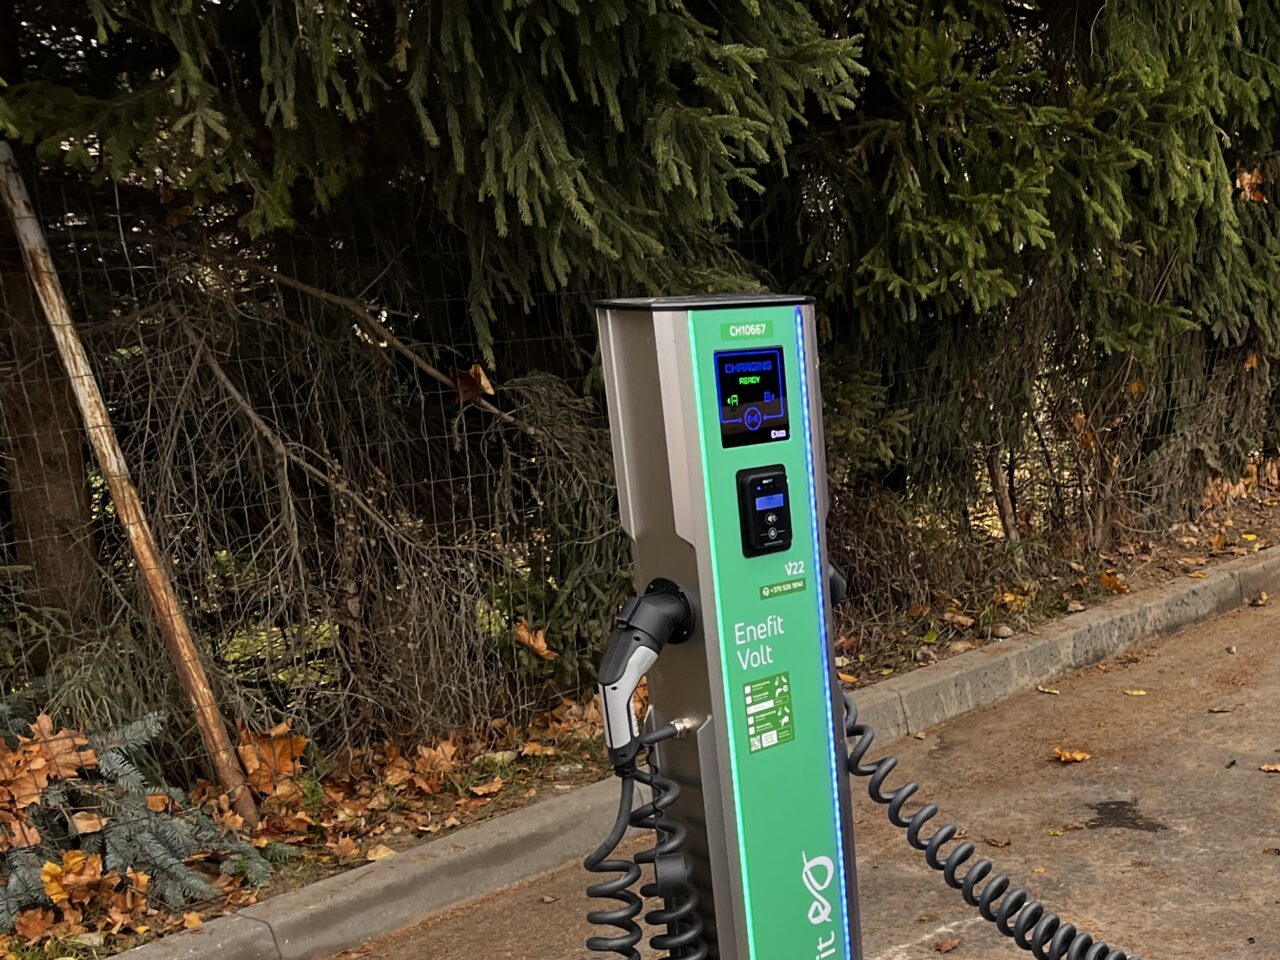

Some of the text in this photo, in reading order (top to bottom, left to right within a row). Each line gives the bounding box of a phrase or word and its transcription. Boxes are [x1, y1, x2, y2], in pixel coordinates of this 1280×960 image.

[729, 323, 766, 337] CH10667
[739, 376, 760, 385] READY
[785, 560, 805, 575] V22
[734, 615, 784, 645] Enefit
[737, 645, 773, 670] Volt
